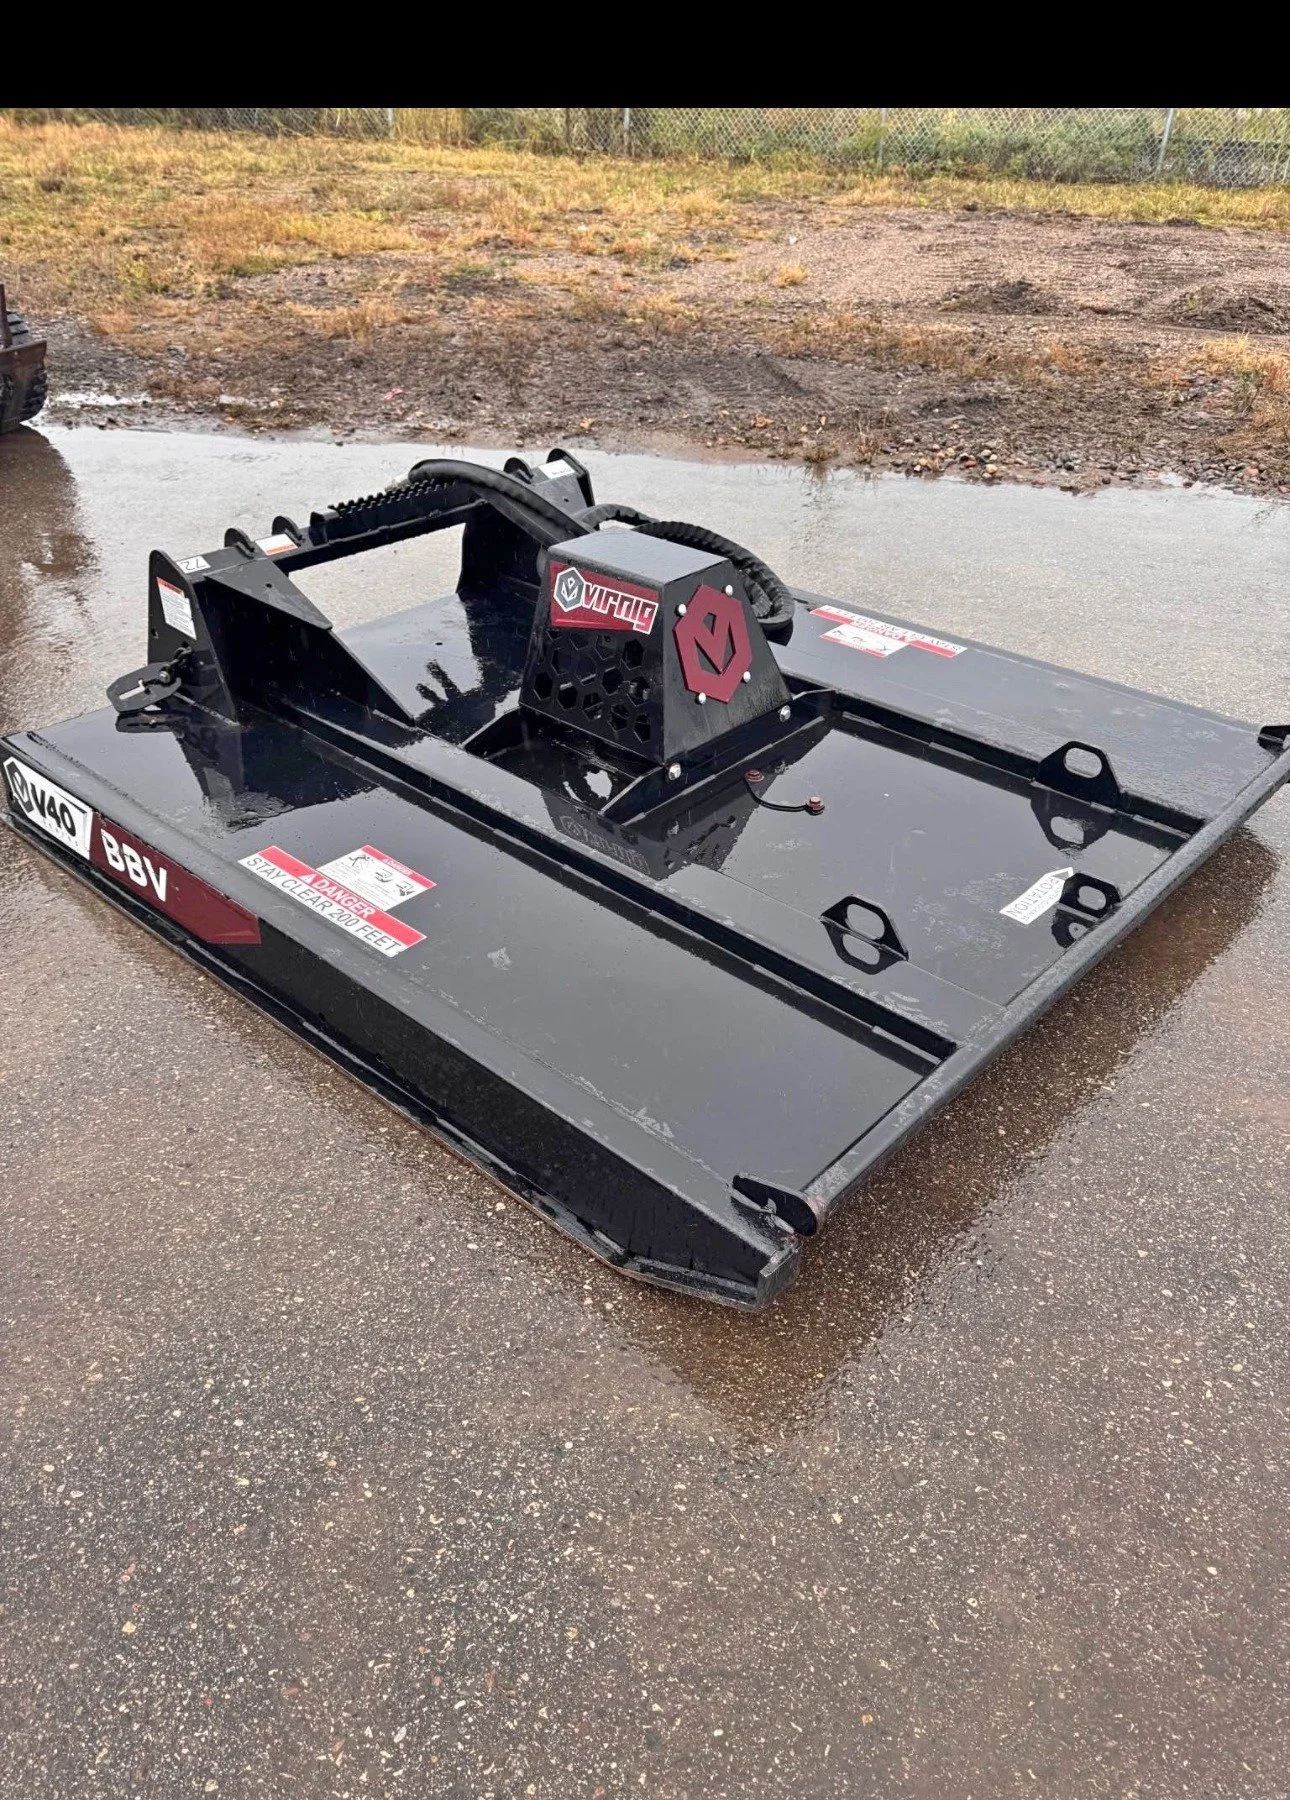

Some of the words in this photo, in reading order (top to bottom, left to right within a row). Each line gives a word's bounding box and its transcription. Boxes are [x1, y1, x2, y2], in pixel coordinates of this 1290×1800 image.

[30, 783, 76, 837] V40
[100, 828, 168, 902] BBV
[246, 857, 284, 881] STAY
[281, 879, 332, 911] CLEAR
[328, 908, 359, 928] 200
[355, 923, 402, 952] FEET
[311, 878, 376, 919] DANGER
